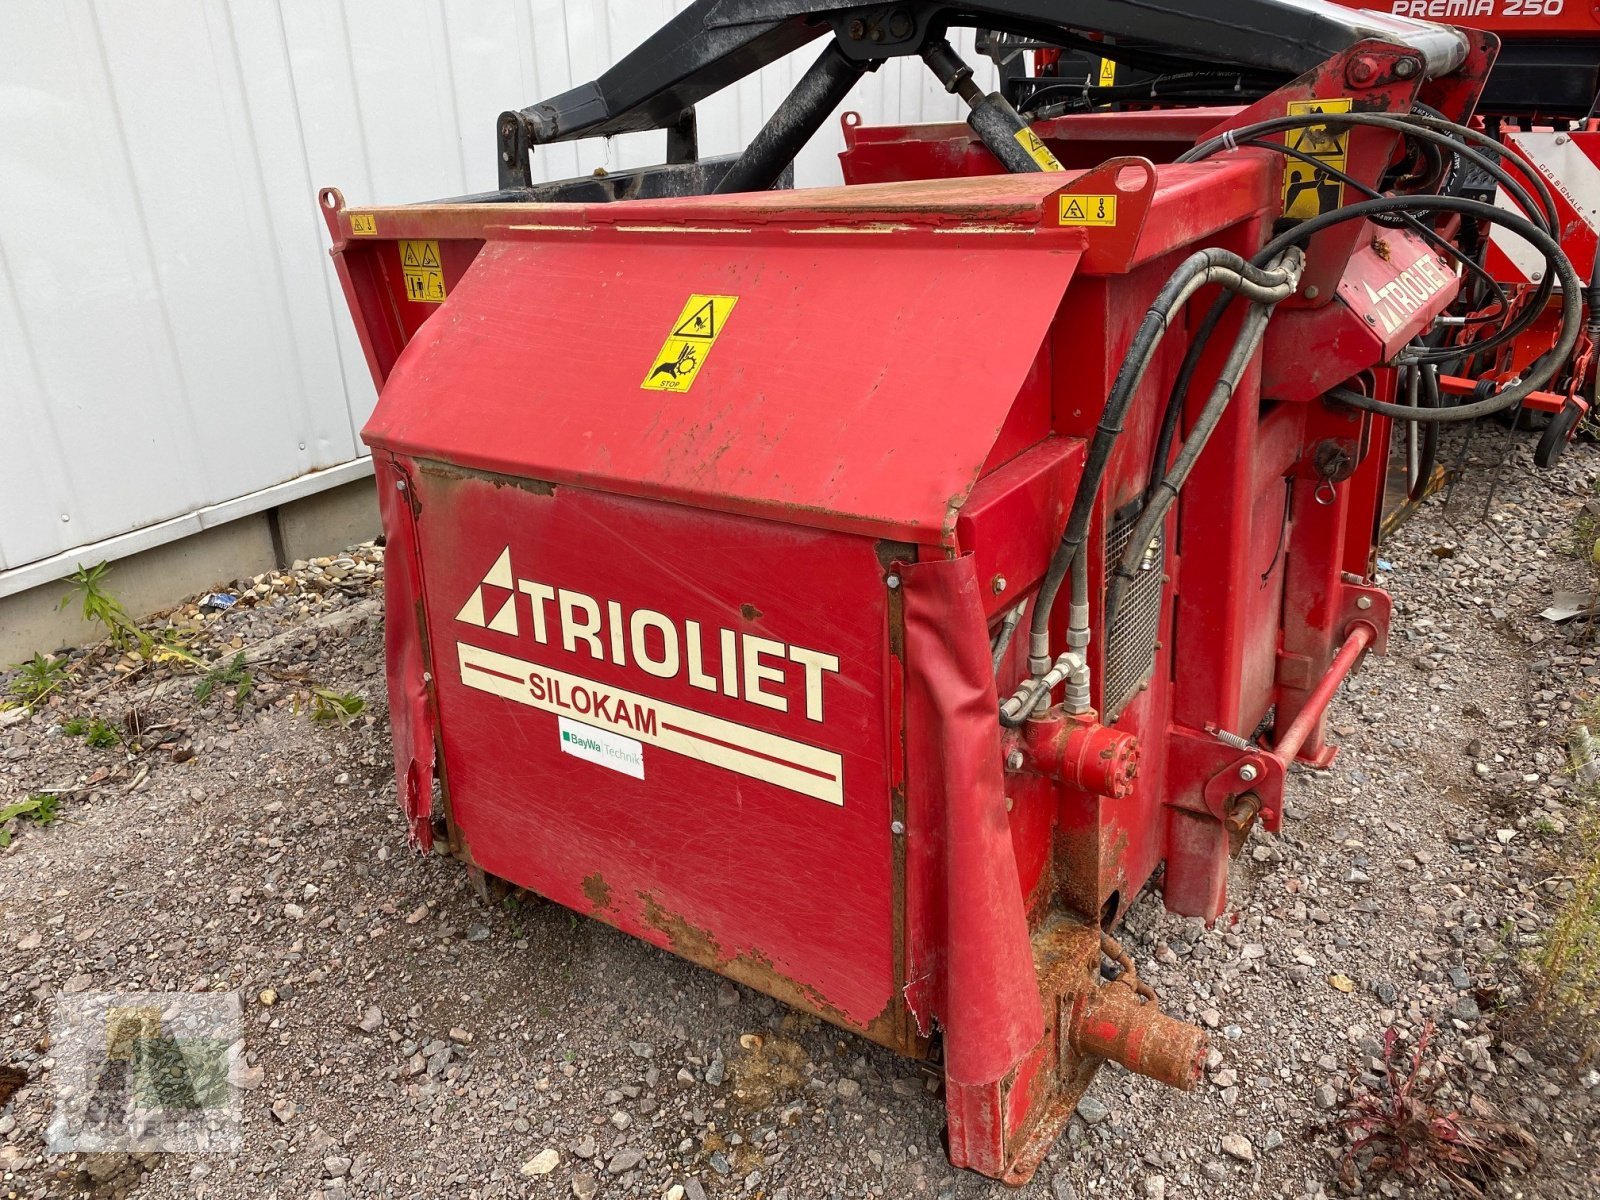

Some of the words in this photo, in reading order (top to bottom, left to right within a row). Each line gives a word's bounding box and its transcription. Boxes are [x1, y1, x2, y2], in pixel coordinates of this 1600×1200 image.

[1392, 0, 1494, 17] PREMIA
[1502, 0, 1564, 16] 250
[1539, 163, 1555, 180] CFG
[1377, 253, 1449, 316] TRIOLIET
[660, 380, 680, 388] STOP
[517, 578, 840, 724] TRIOLIET
[528, 672, 657, 736] SILOKAM
[571, 733, 602, 753] BayWa
[604, 743, 641, 766] Technik
